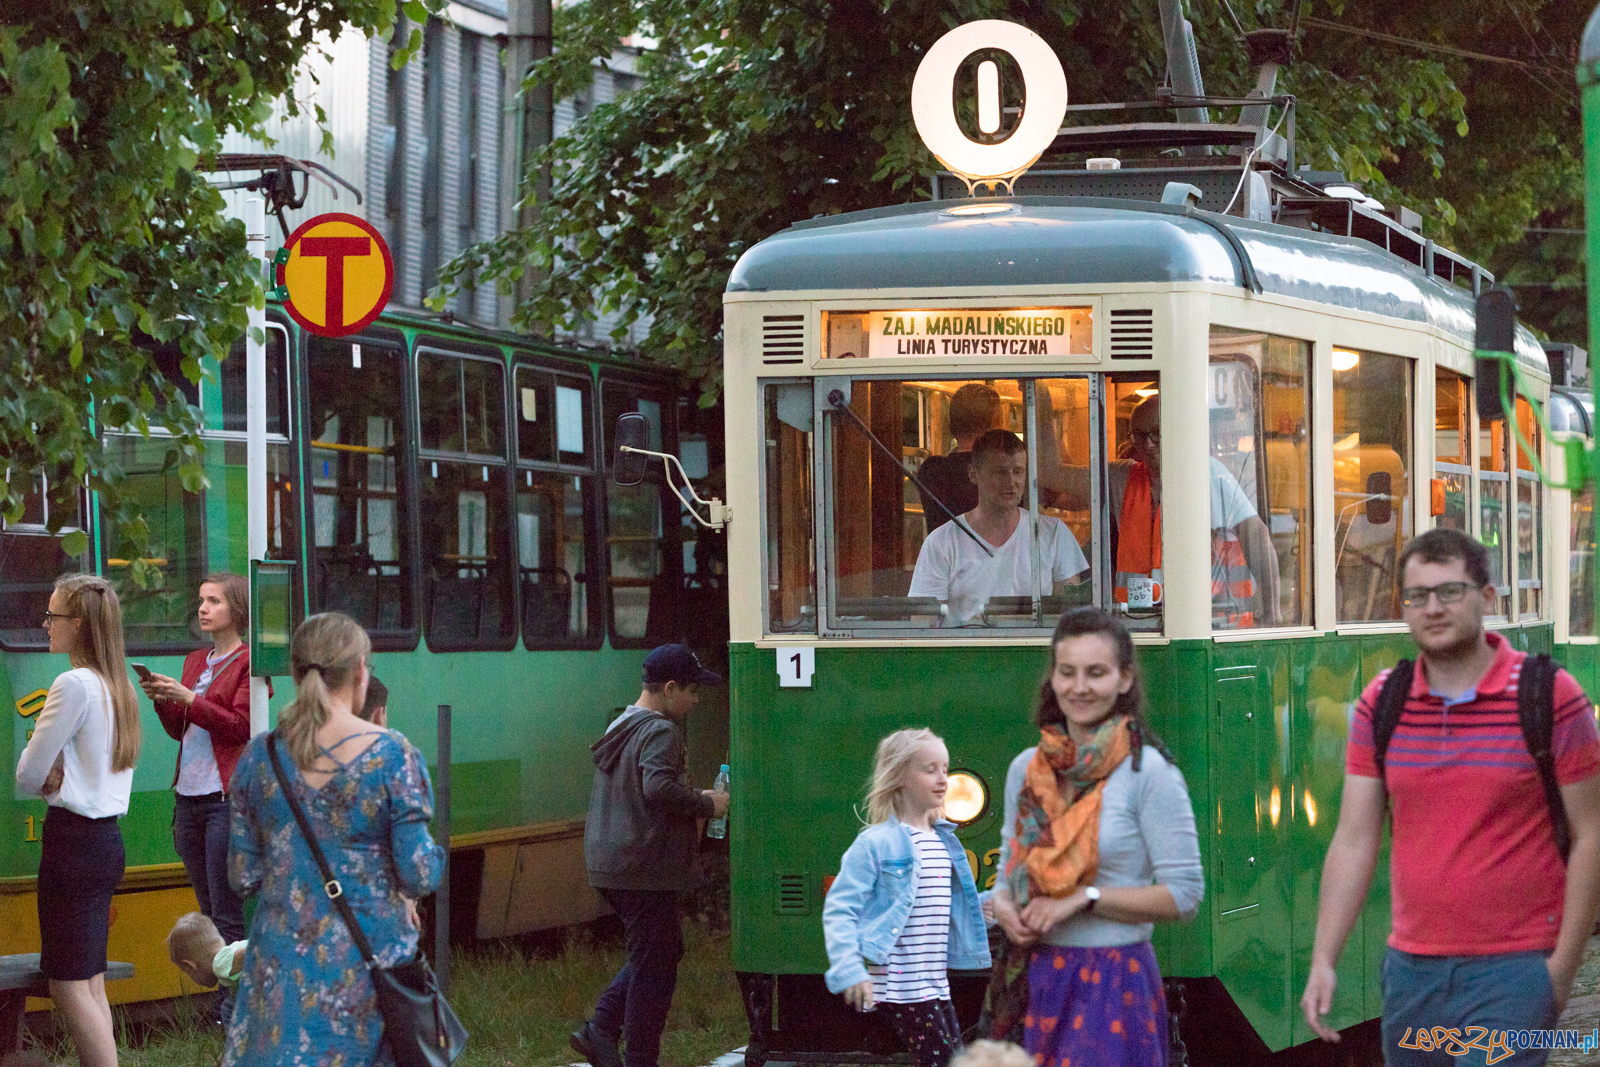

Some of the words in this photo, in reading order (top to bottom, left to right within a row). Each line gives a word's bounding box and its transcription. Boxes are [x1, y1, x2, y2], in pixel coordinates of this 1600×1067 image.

[299, 235, 372, 328] T
[882, 316, 920, 336] ZAJ.
[926, 313, 1065, 336] MADALIŃSKIEGO
[897, 339, 936, 355] LINIA
[941, 338, 1048, 355] TURYSTYCZNA
[790, 652, 801, 679] 1
